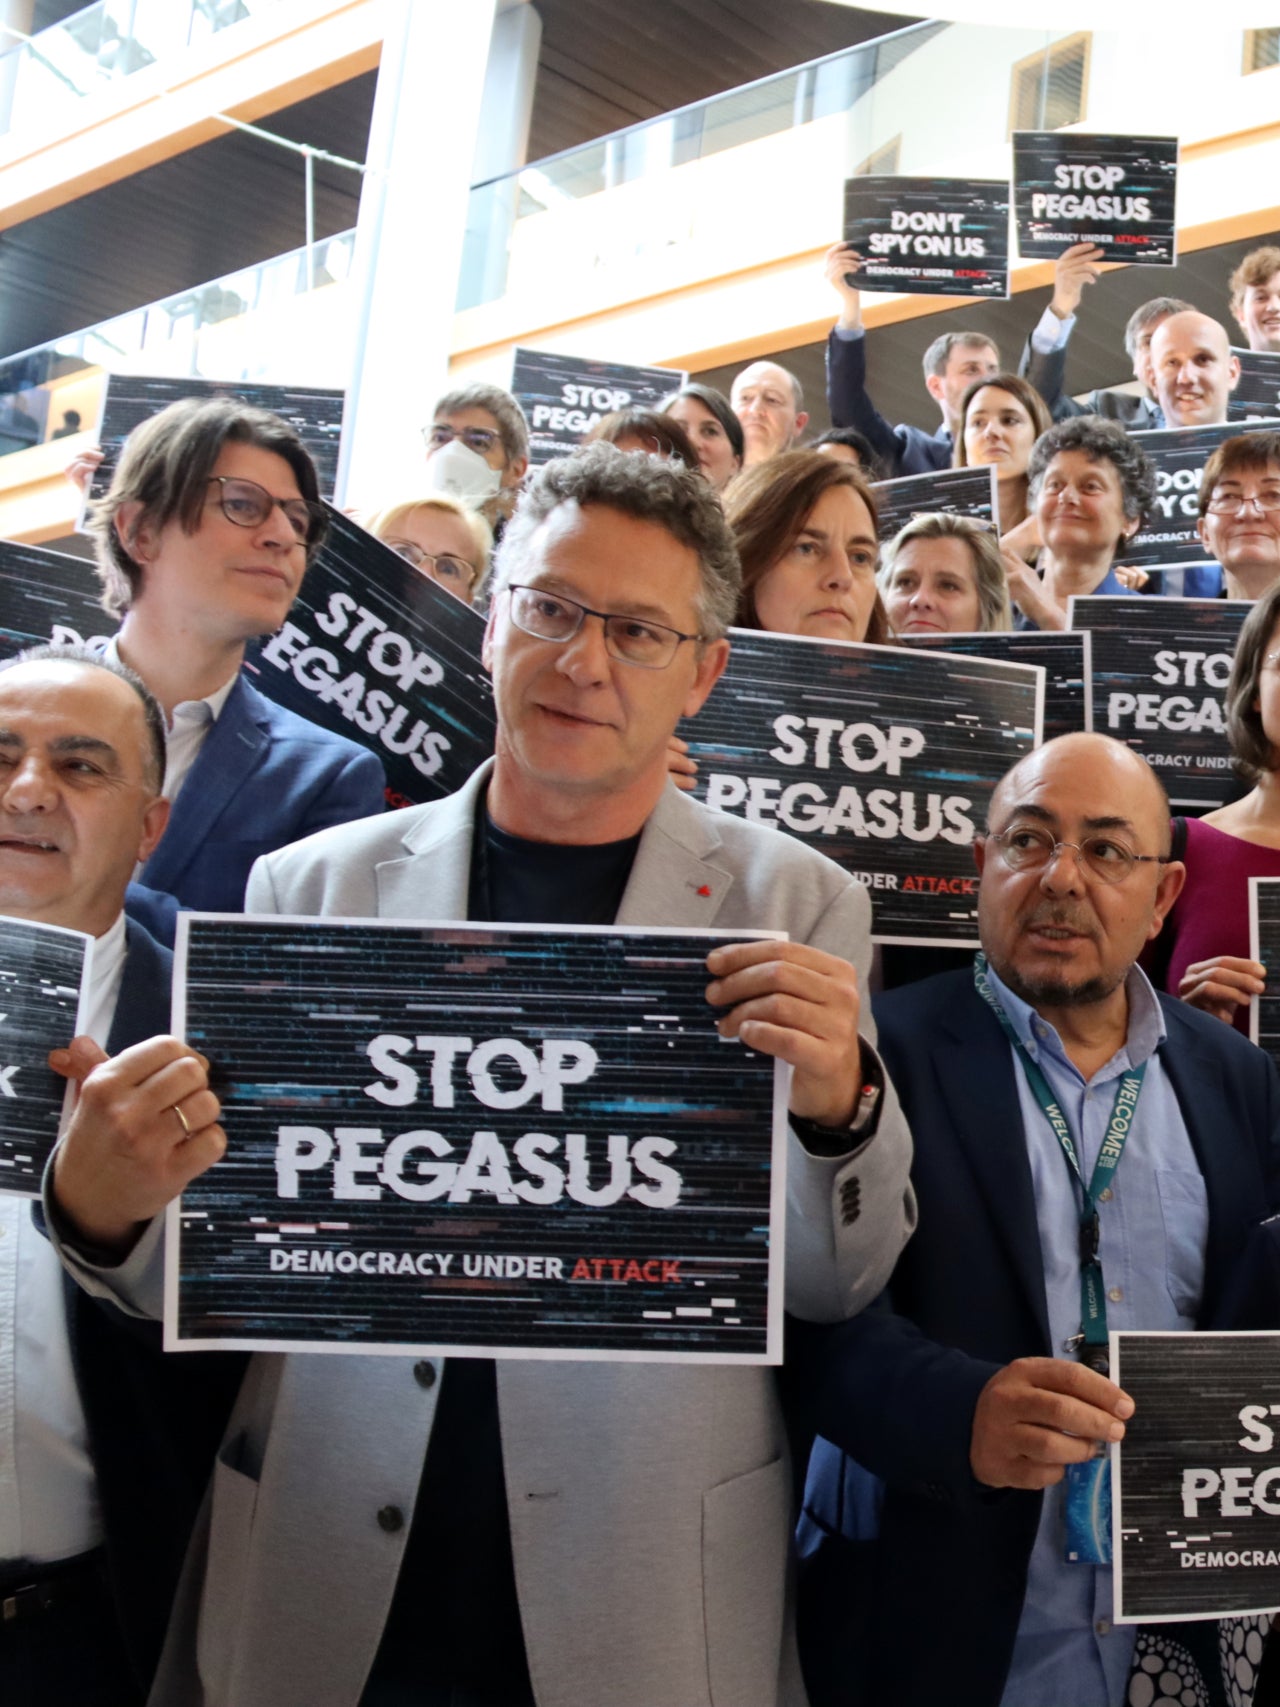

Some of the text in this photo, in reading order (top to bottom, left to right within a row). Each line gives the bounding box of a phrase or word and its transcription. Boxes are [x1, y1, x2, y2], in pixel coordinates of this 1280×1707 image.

[1054, 165, 1125, 190] STOP
[890, 210, 965, 232] DON'T
[1031, 193, 1151, 221] PEGASUS
[868, 233, 986, 258] SPY ON US
[1033, 232, 1150, 244] DEMOCRACY UNDER ATTACK
[866, 265, 988, 279] DEMOCRACY UNDER ATTACK
[561, 383, 631, 411] STOP
[532, 405, 602, 433] PEGA
[529, 439, 579, 451] DEMOCRAC
[314, 592, 444, 692] STOP
[1152, 650, 1235, 689] STO
[262, 621, 451, 776] EGASUS
[1107, 692, 1232, 734] PEGA
[770, 713, 925, 776] STOP
[706, 773, 976, 846] PEGASUS
[902, 876, 975, 897] ATTACK
[364, 1033, 599, 1112] STOP
[1101, 1078, 1141, 1157] WELCOME
[1045, 1104, 1080, 1174] WELCO
[272, 1125, 684, 1208] PEGASUS
[269, 1248, 680, 1283] DEMOCRACY UNDER ATTACK
